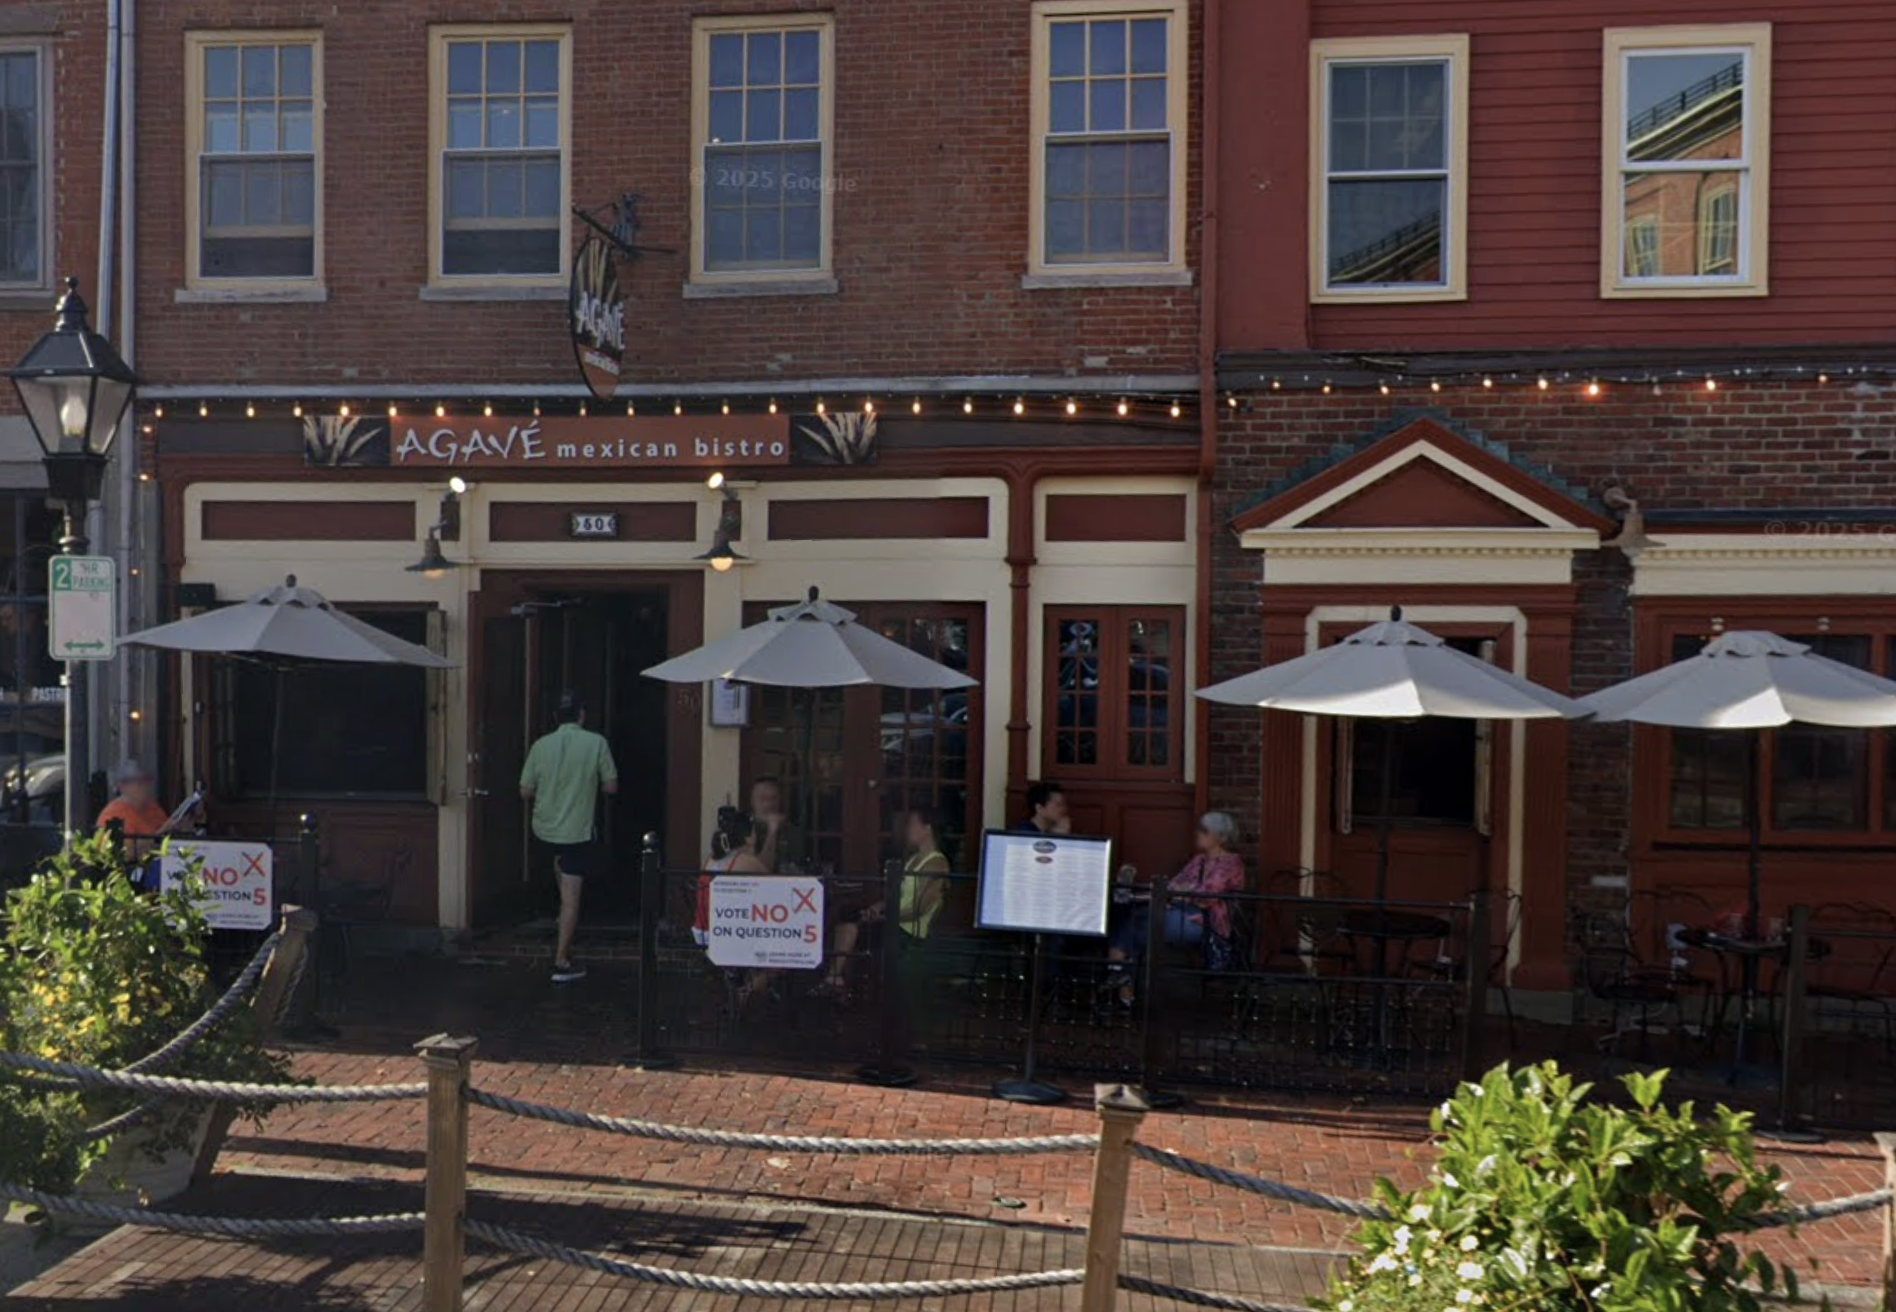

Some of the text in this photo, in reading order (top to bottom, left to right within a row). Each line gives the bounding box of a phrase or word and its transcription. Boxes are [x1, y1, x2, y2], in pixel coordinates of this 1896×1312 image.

[395, 420, 785, 465] AGAVÉ mexican bistro
[55, 562, 99, 588] 2 HR
[203, 868, 238, 886] NO
[253, 888, 266, 905] 5
[715, 904, 789, 922] VOTE NO
[713, 924, 817, 943] ON QUESTION 5
